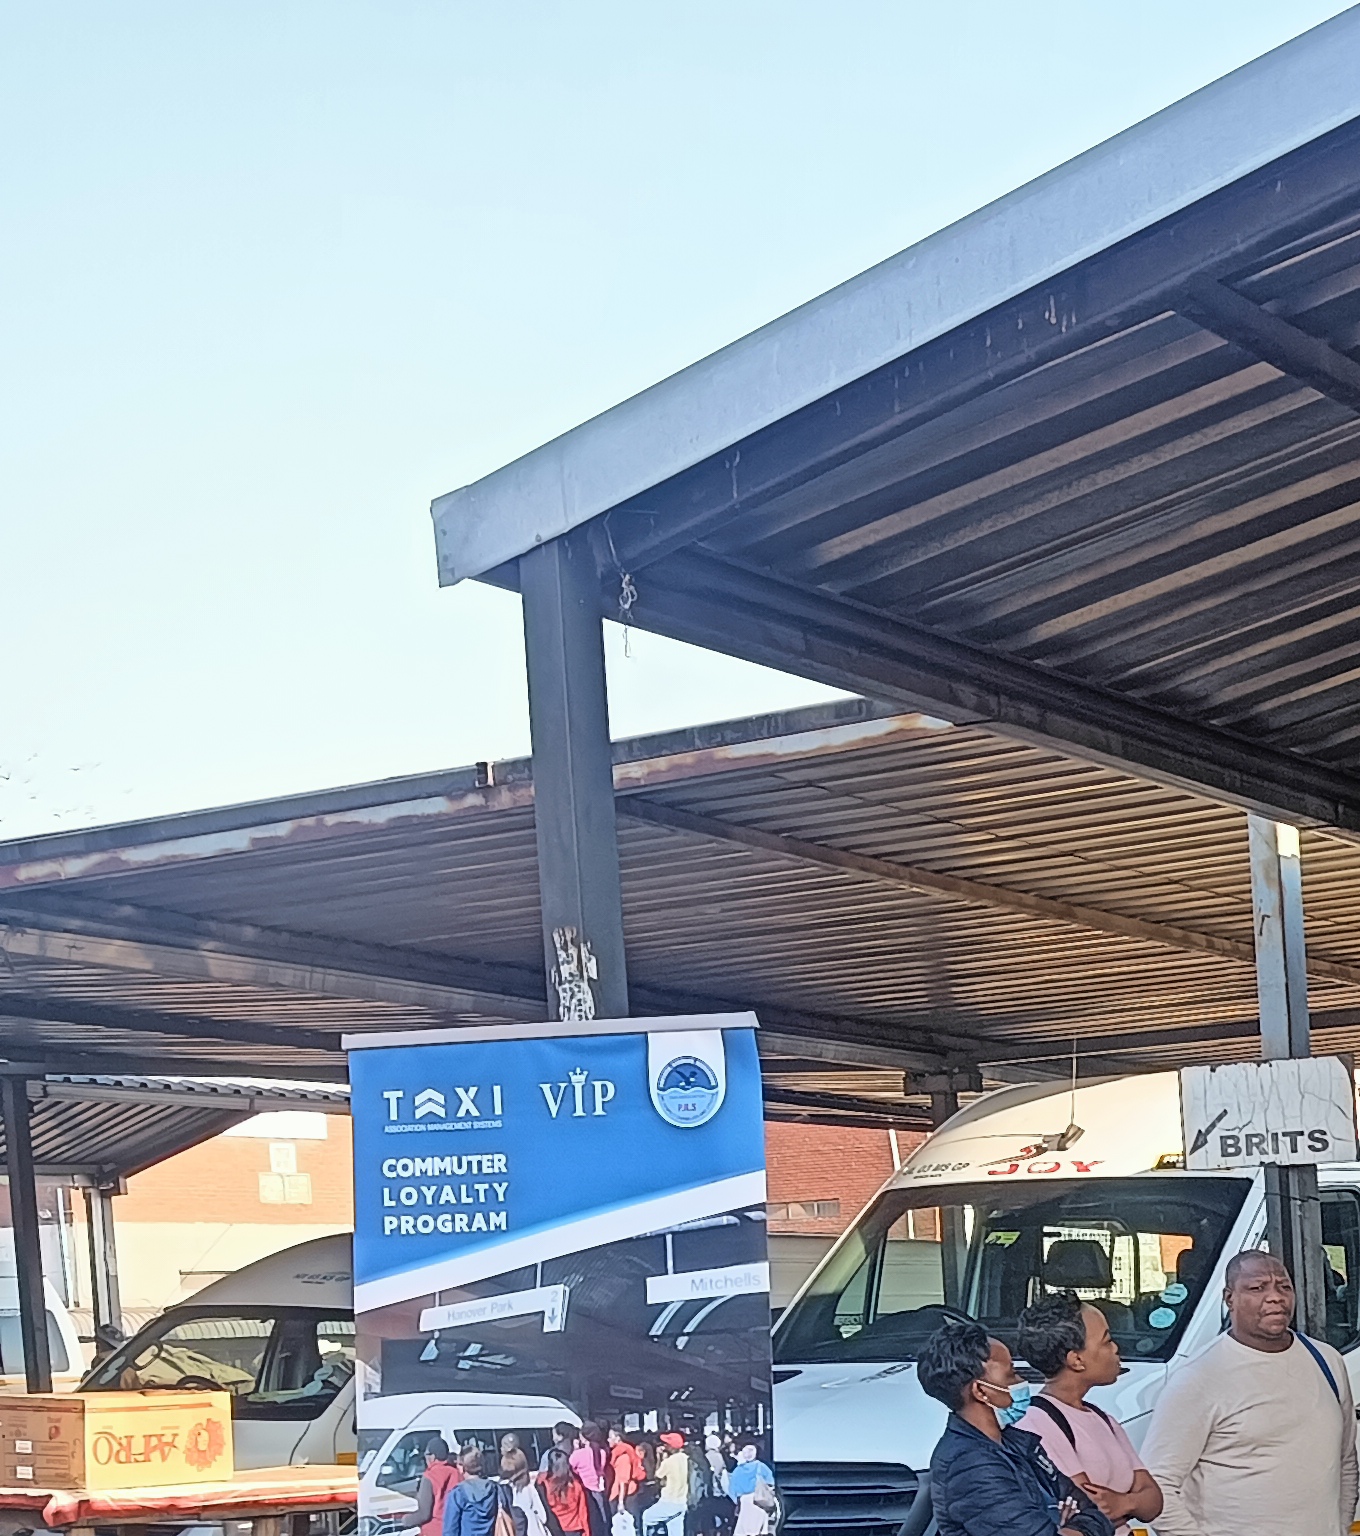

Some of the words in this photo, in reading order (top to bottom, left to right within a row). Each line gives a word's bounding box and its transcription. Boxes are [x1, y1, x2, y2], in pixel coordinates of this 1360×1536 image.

[539, 1080, 616, 1118] VIP
[1219, 1129, 1330, 1158] BRITS
[382, 1153, 508, 1178] COMMUTER
[987, 1160, 1105, 1176] JOY
[383, 1182, 509, 1207] LOYALTY
[384, 1211, 507, 1235] PROGRAM
[690, 1271, 762, 1292] Mitchells
[550, 1290, 560, 1303] 2
[447, 1306, 487, 1321] Hanover
[491, 1300, 514, 1315] Park
[92, 1432, 180, 1466] AFRO
